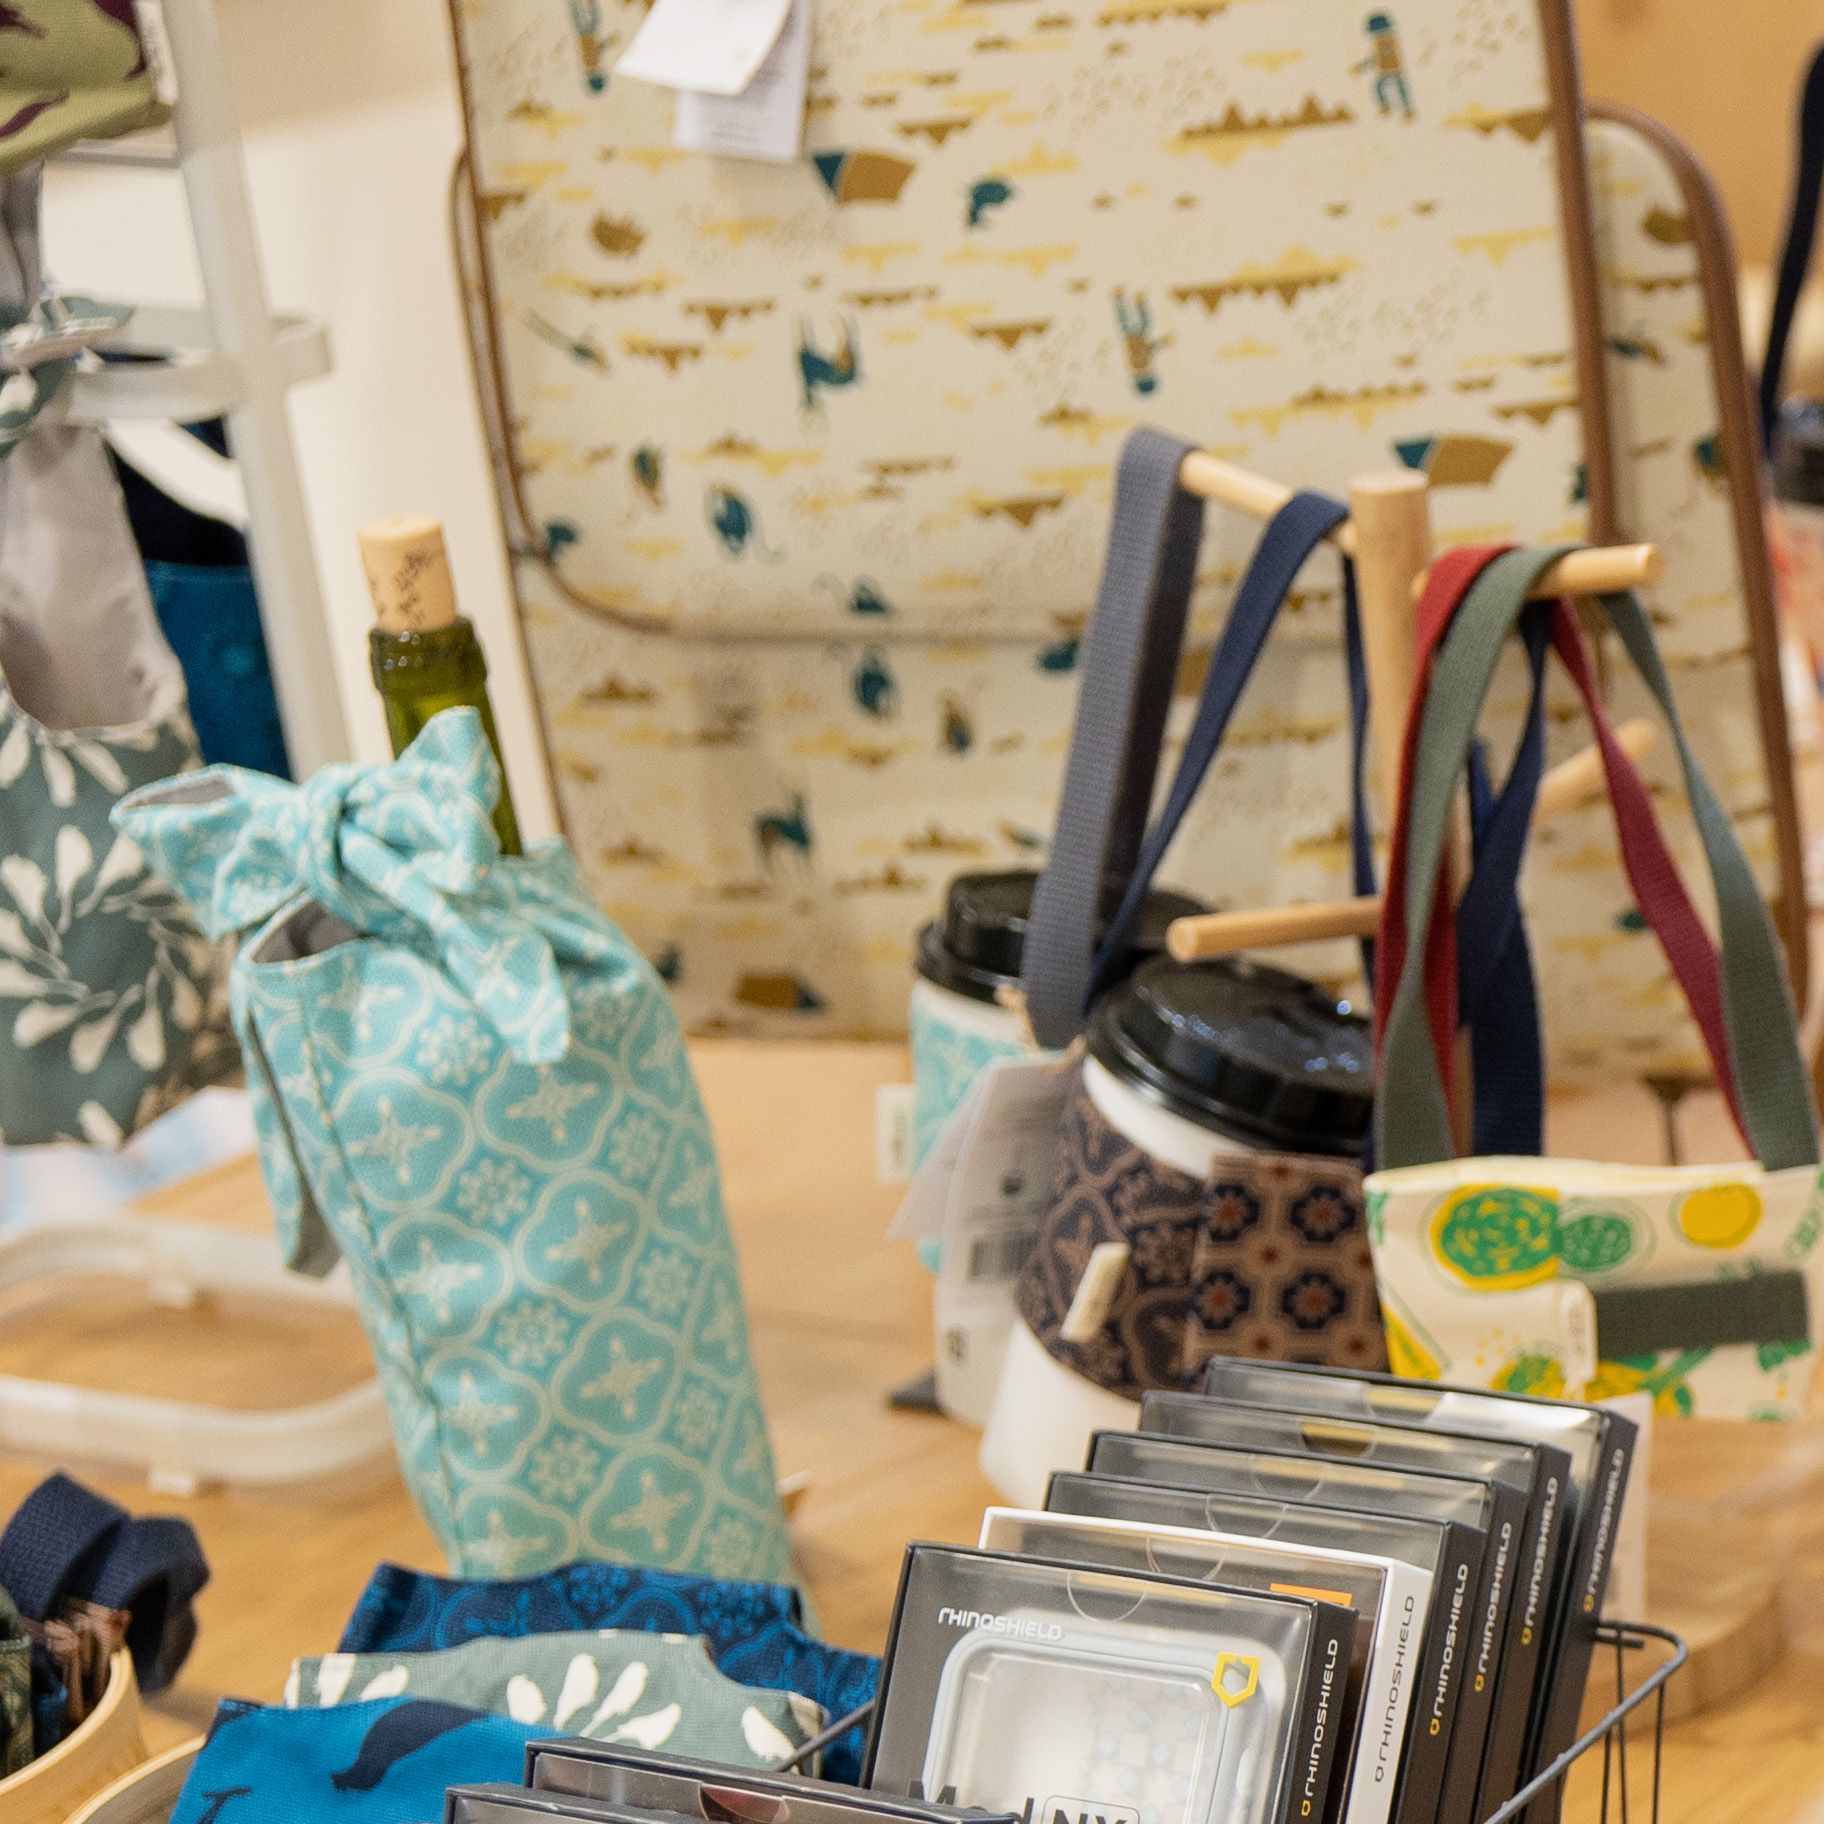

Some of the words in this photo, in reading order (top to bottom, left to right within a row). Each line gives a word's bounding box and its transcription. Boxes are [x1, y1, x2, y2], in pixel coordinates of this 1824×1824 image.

[938, 1607, 1063, 1641] RHINOSHIELD
[1434, 1564, 1469, 1717] RHINOSHIELD
[1479, 1522, 1512, 1674] RHINOSHIELD
[1305, 1639, 1340, 1798] RHINOSHIELD
[1380, 1595, 1415, 1763] RHINOSHIELD
